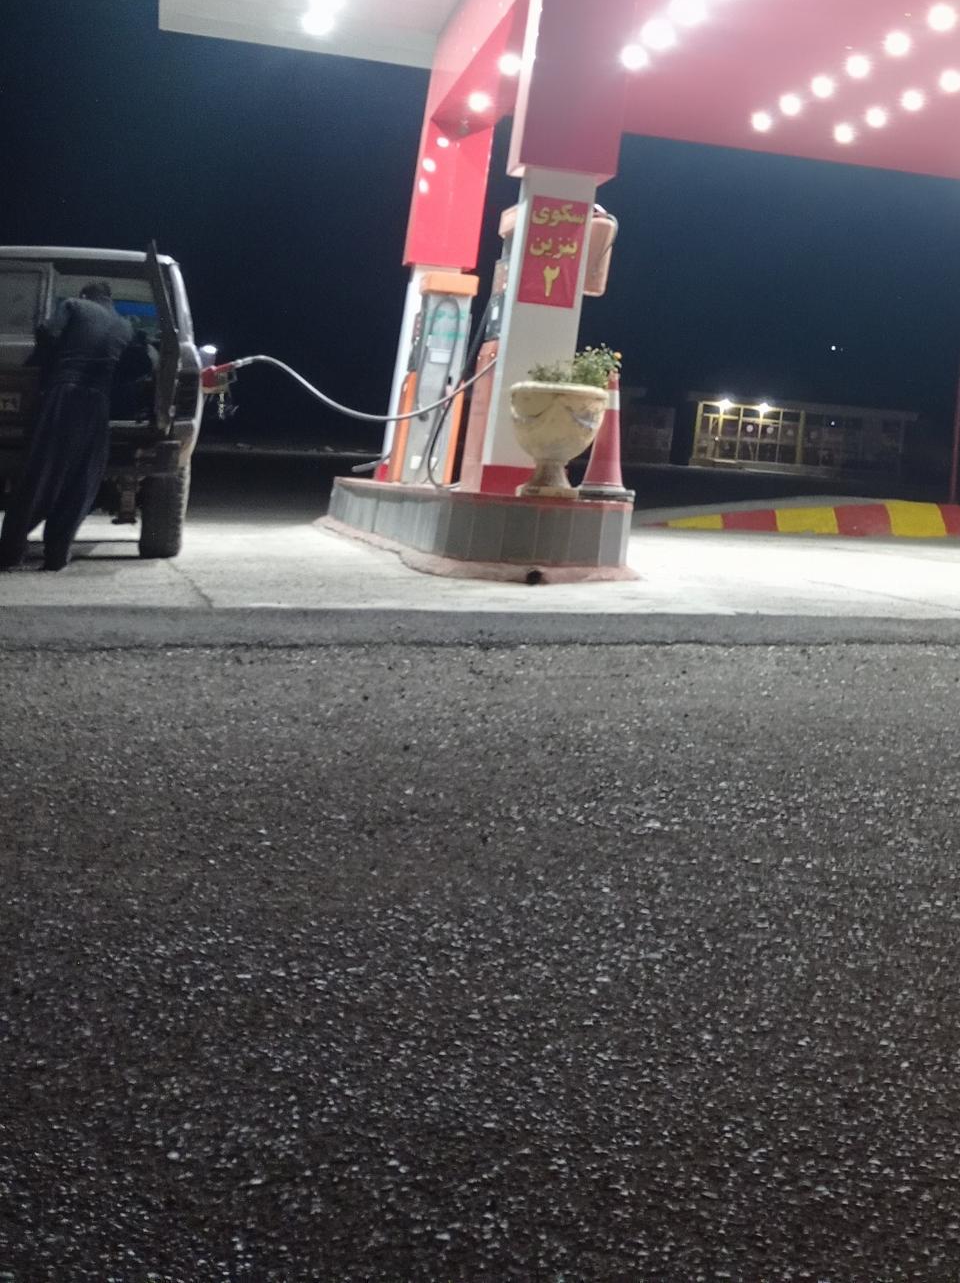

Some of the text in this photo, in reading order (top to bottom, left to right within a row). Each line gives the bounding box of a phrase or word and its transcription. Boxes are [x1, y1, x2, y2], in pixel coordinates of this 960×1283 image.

[532, 203, 585, 227] سکوی
[529, 237, 578, 260] بنزین
[543, 265, 561, 297] ۲
